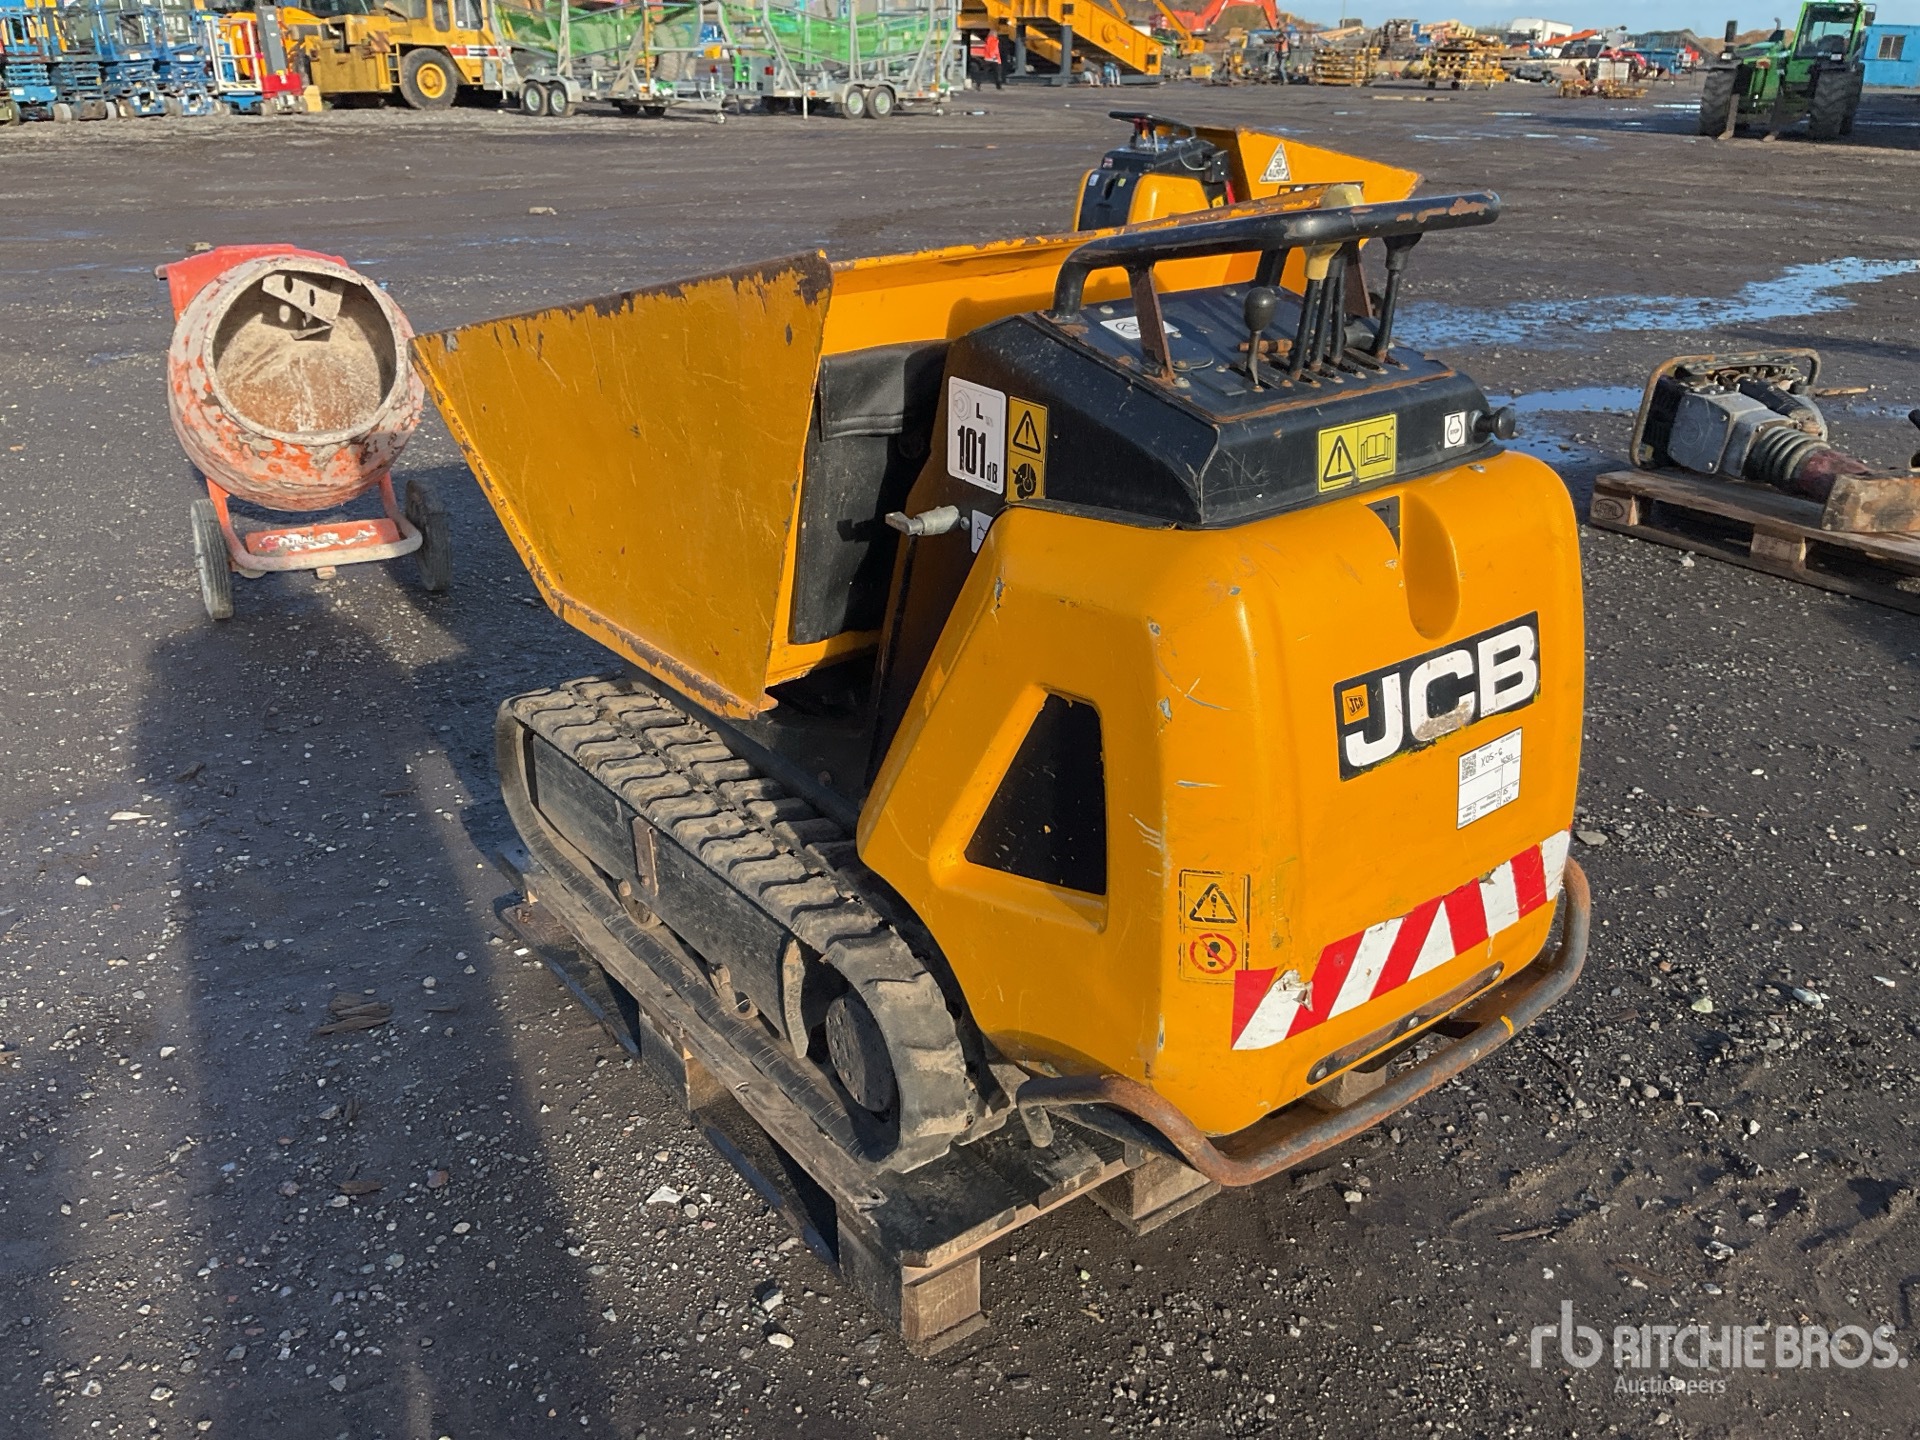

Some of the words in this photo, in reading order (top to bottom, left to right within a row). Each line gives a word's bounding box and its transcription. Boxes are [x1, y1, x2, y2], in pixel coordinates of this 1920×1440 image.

[975, 402, 984, 420] L
[957, 424, 987, 479] 101
[986, 461, 998, 484] dB
[1345, 624, 1537, 768] JCB
[1349, 697, 1364, 713] JCB
